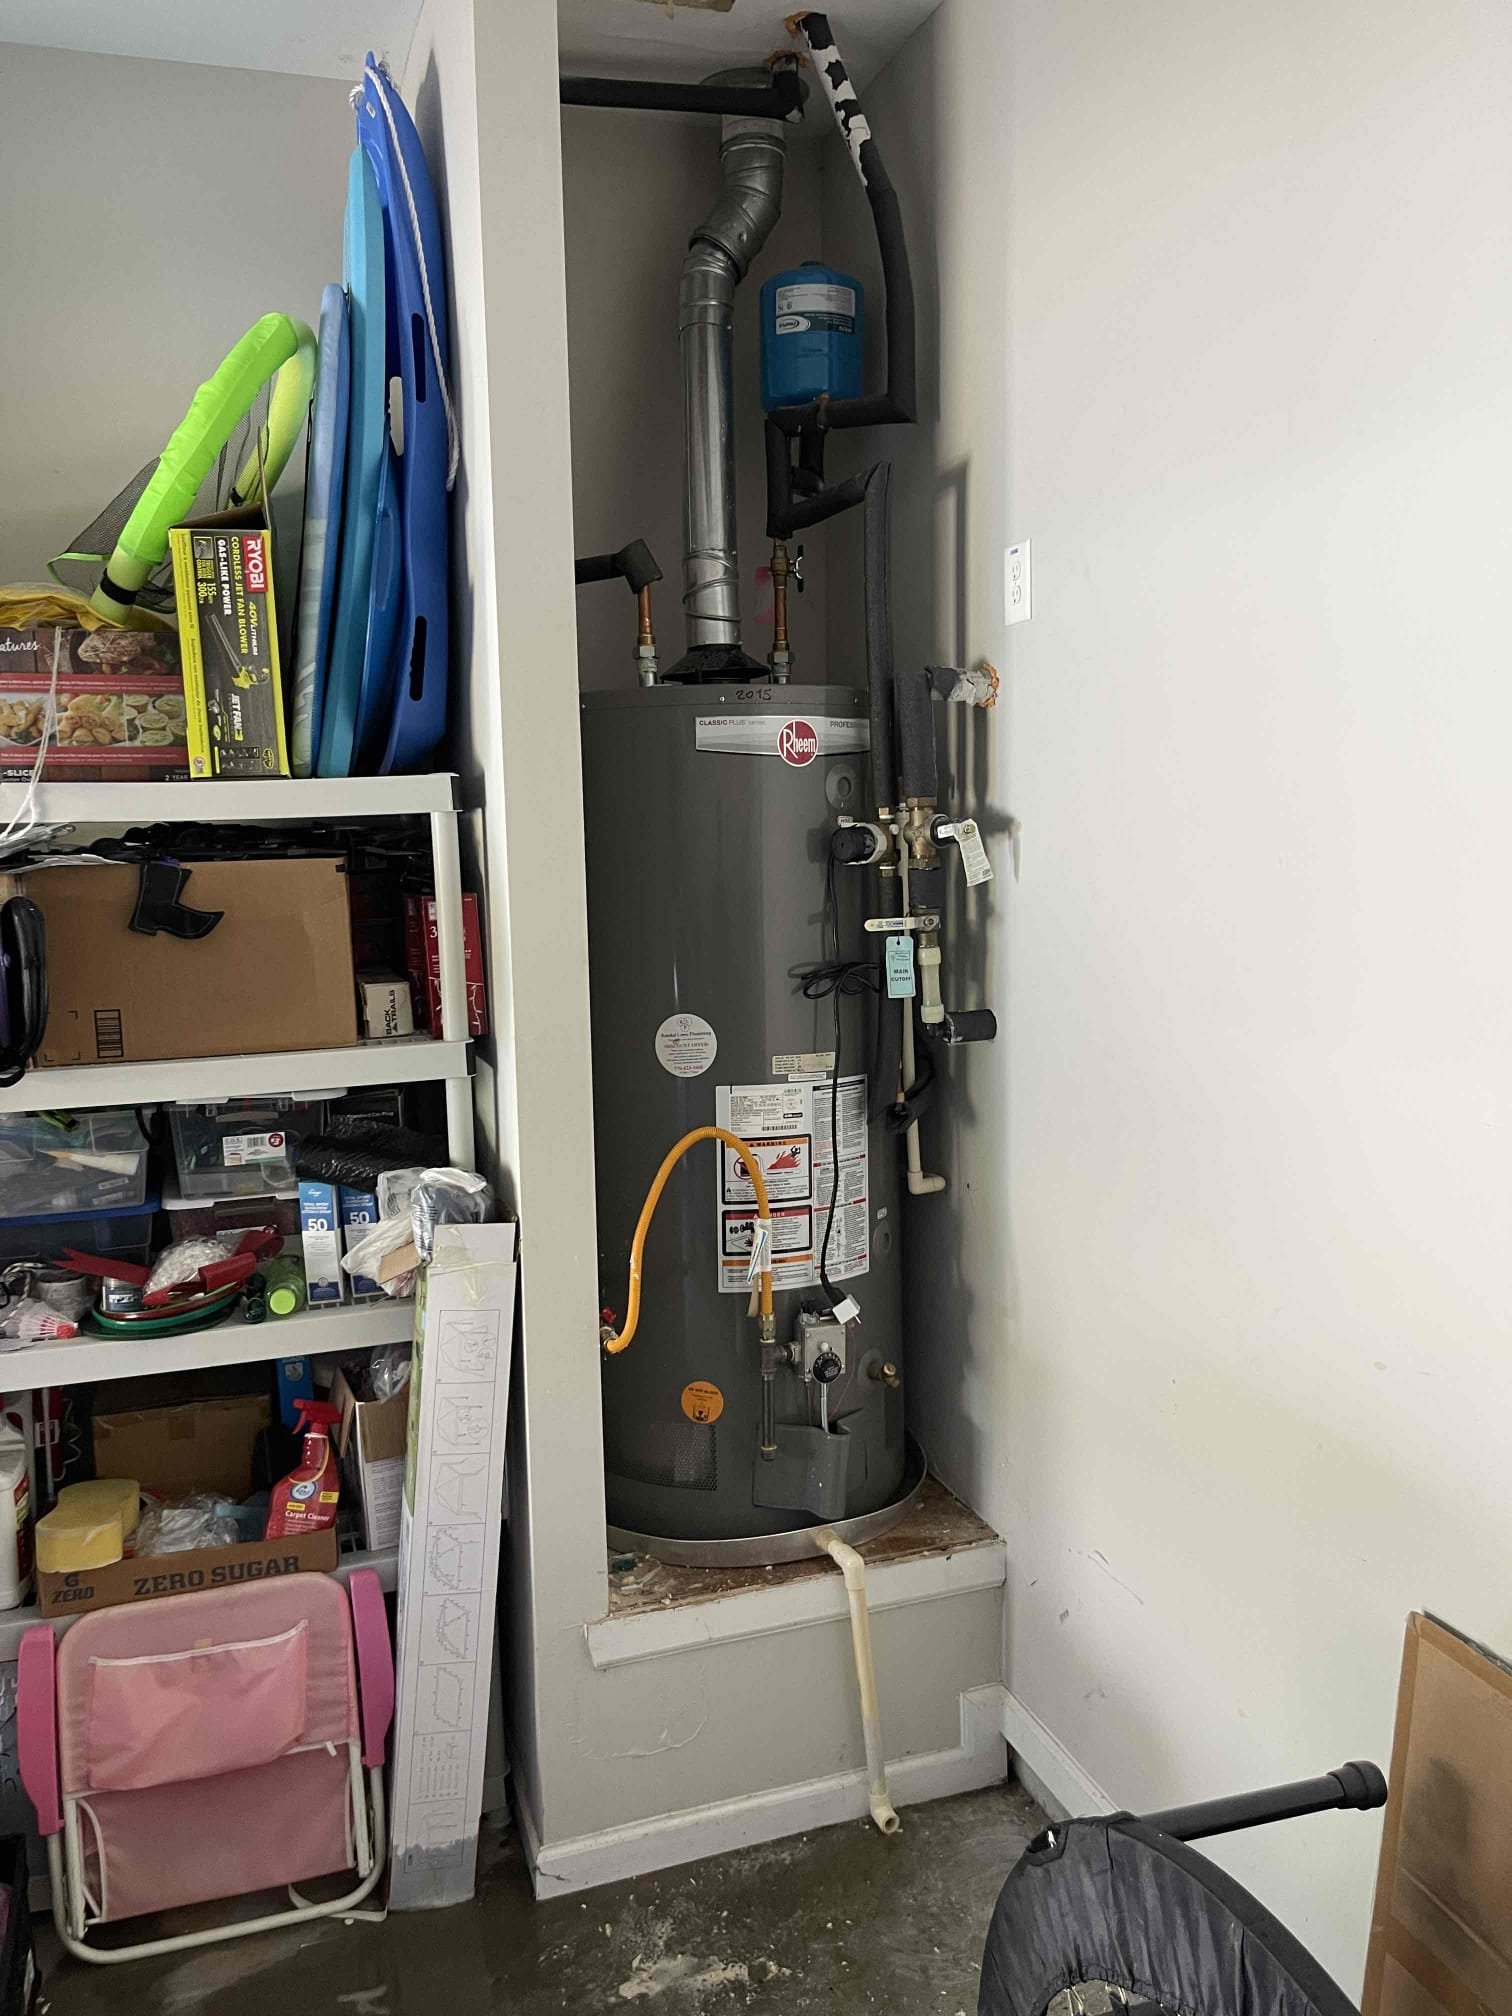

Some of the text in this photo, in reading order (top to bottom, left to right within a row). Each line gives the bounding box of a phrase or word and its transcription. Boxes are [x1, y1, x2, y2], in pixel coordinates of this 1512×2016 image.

[246, 538, 265, 589] RYOBI
[217, 539, 232, 616] GAS-LIKE POWER
[231, 536, 249, 655] CORDLESS JET FAN BLOWER
[735, 688, 773, 701] 2015
[231, 693, 242, 730] JET FAN
[782, 721, 816, 759] Rheem
[384, 1009, 392, 1035] BACK
[307, 1218, 328, 1231] 50
[349, 1211, 370, 1225] 50
[285, 1510, 331, 1521] Carpet Cleaner
[64, 1572, 80, 1588] G
[133, 1556, 300, 1596] ZERO SUGAR
[52, 1587, 95, 1605] ZERO
